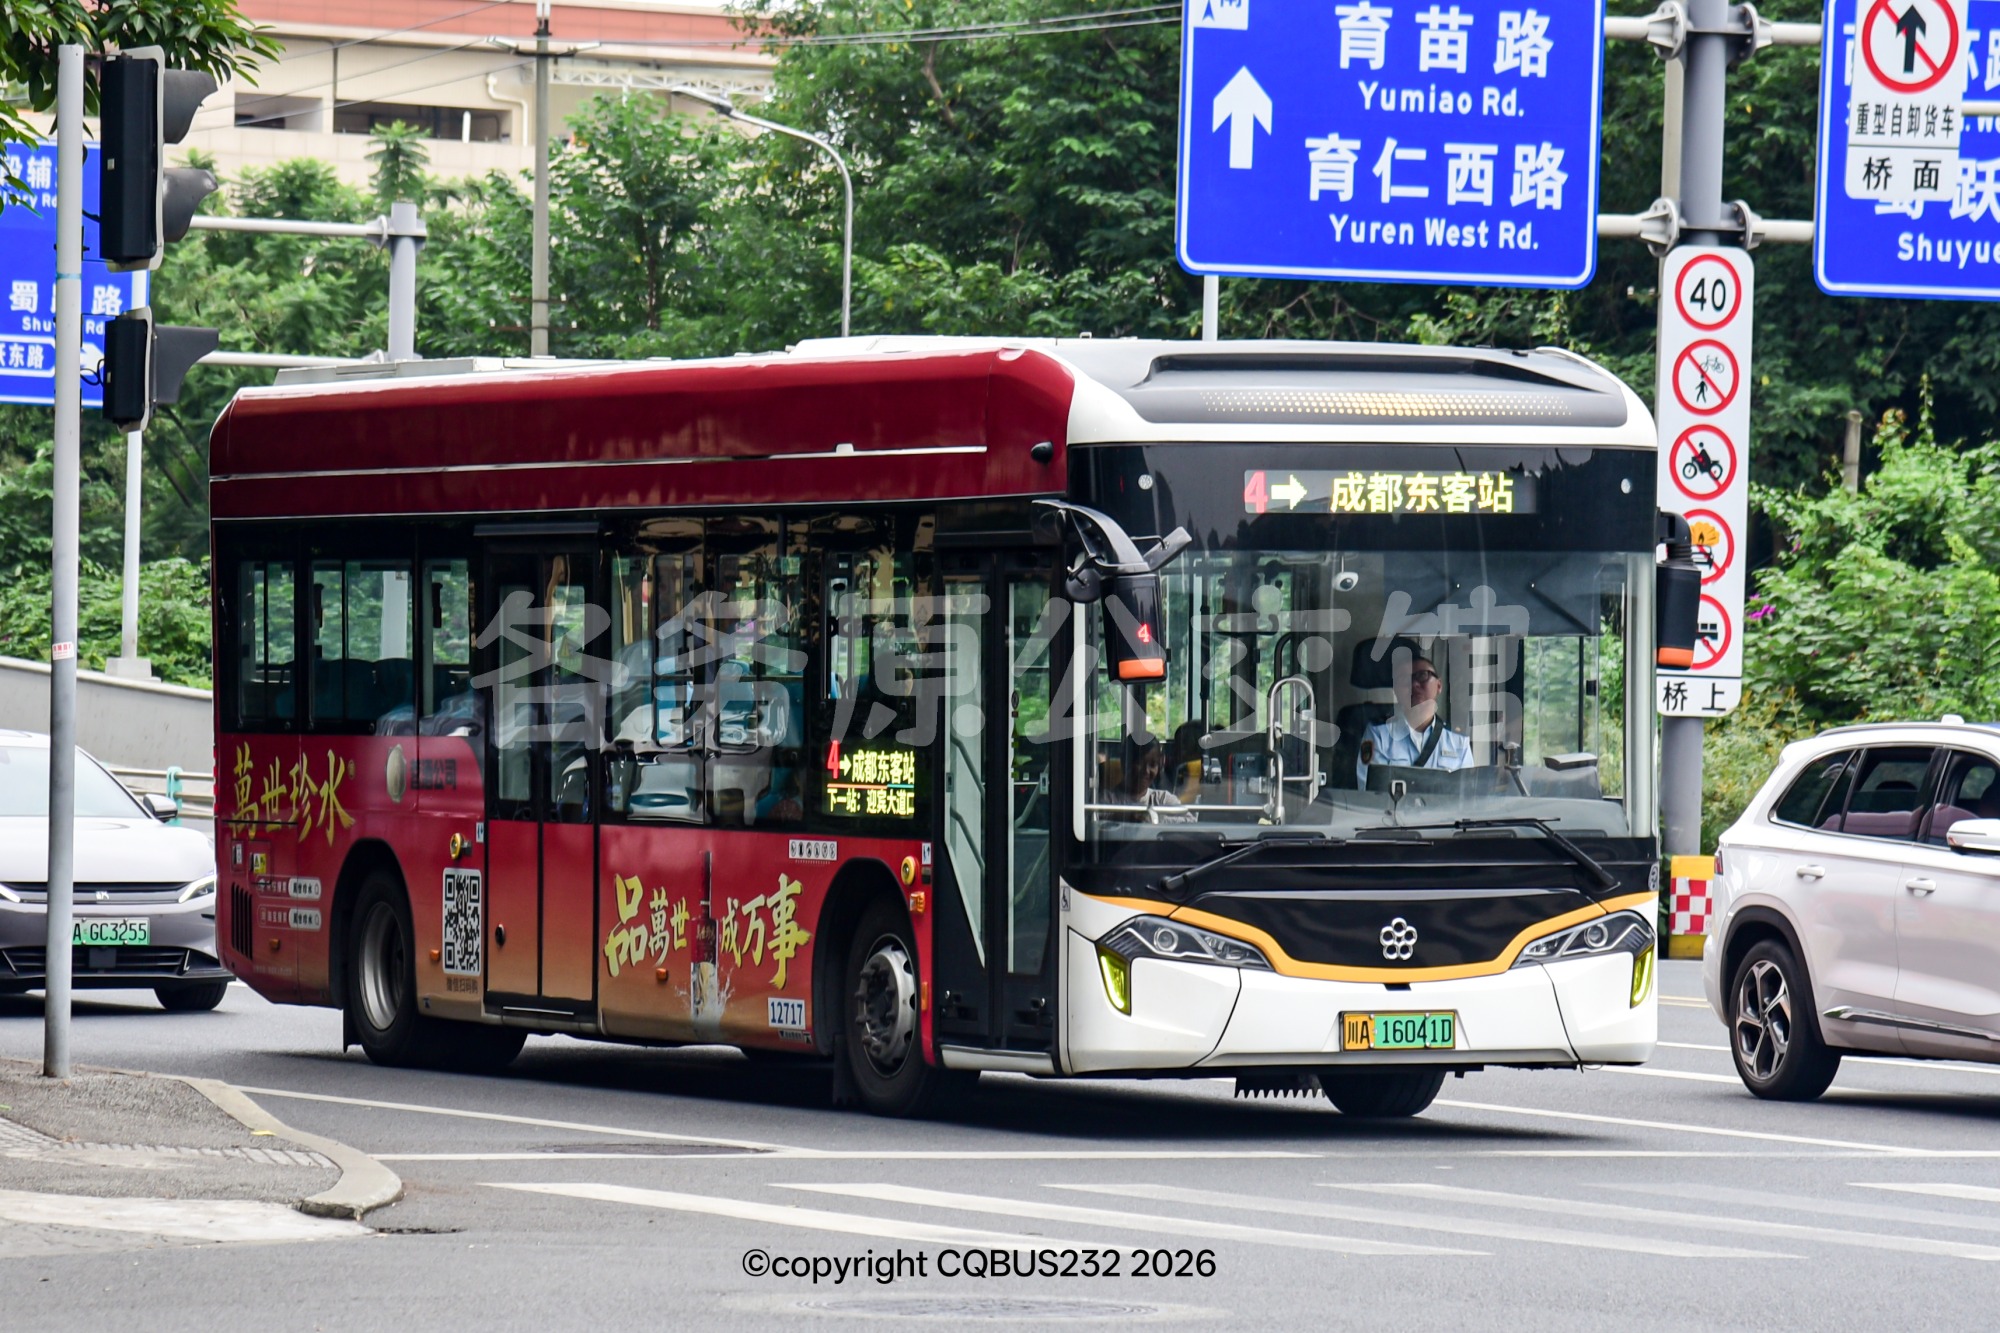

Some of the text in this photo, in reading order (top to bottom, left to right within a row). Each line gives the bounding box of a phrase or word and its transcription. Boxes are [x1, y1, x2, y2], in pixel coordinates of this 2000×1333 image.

[1335, 1, 1554, 78] 育苗路
[1358, 80, 1525, 117] Yumiao Rd.
[1855, 102, 1954, 139] 重型自卸货车
[1305, 132, 1568, 210] 育仁西路
[1862, 155, 1942, 192] 桥面
[1329, 213, 1538, 250] Yuren West Rd.
[9, 281, 122, 316] 蜀路
[1689, 277, 1727, 314] 40
[1244, 471, 1513, 513] 4 成都东客站
[1137, 623, 1151, 643] 4
[1663, 681, 1726, 712] 桥上
[827, 740, 915, 784] 4 成都东客站
[90, 923, 147, 942] GC3255
[770, 1001, 803, 1026] 12717
[1347, 1019, 1452, 1045] 川A 16041D
